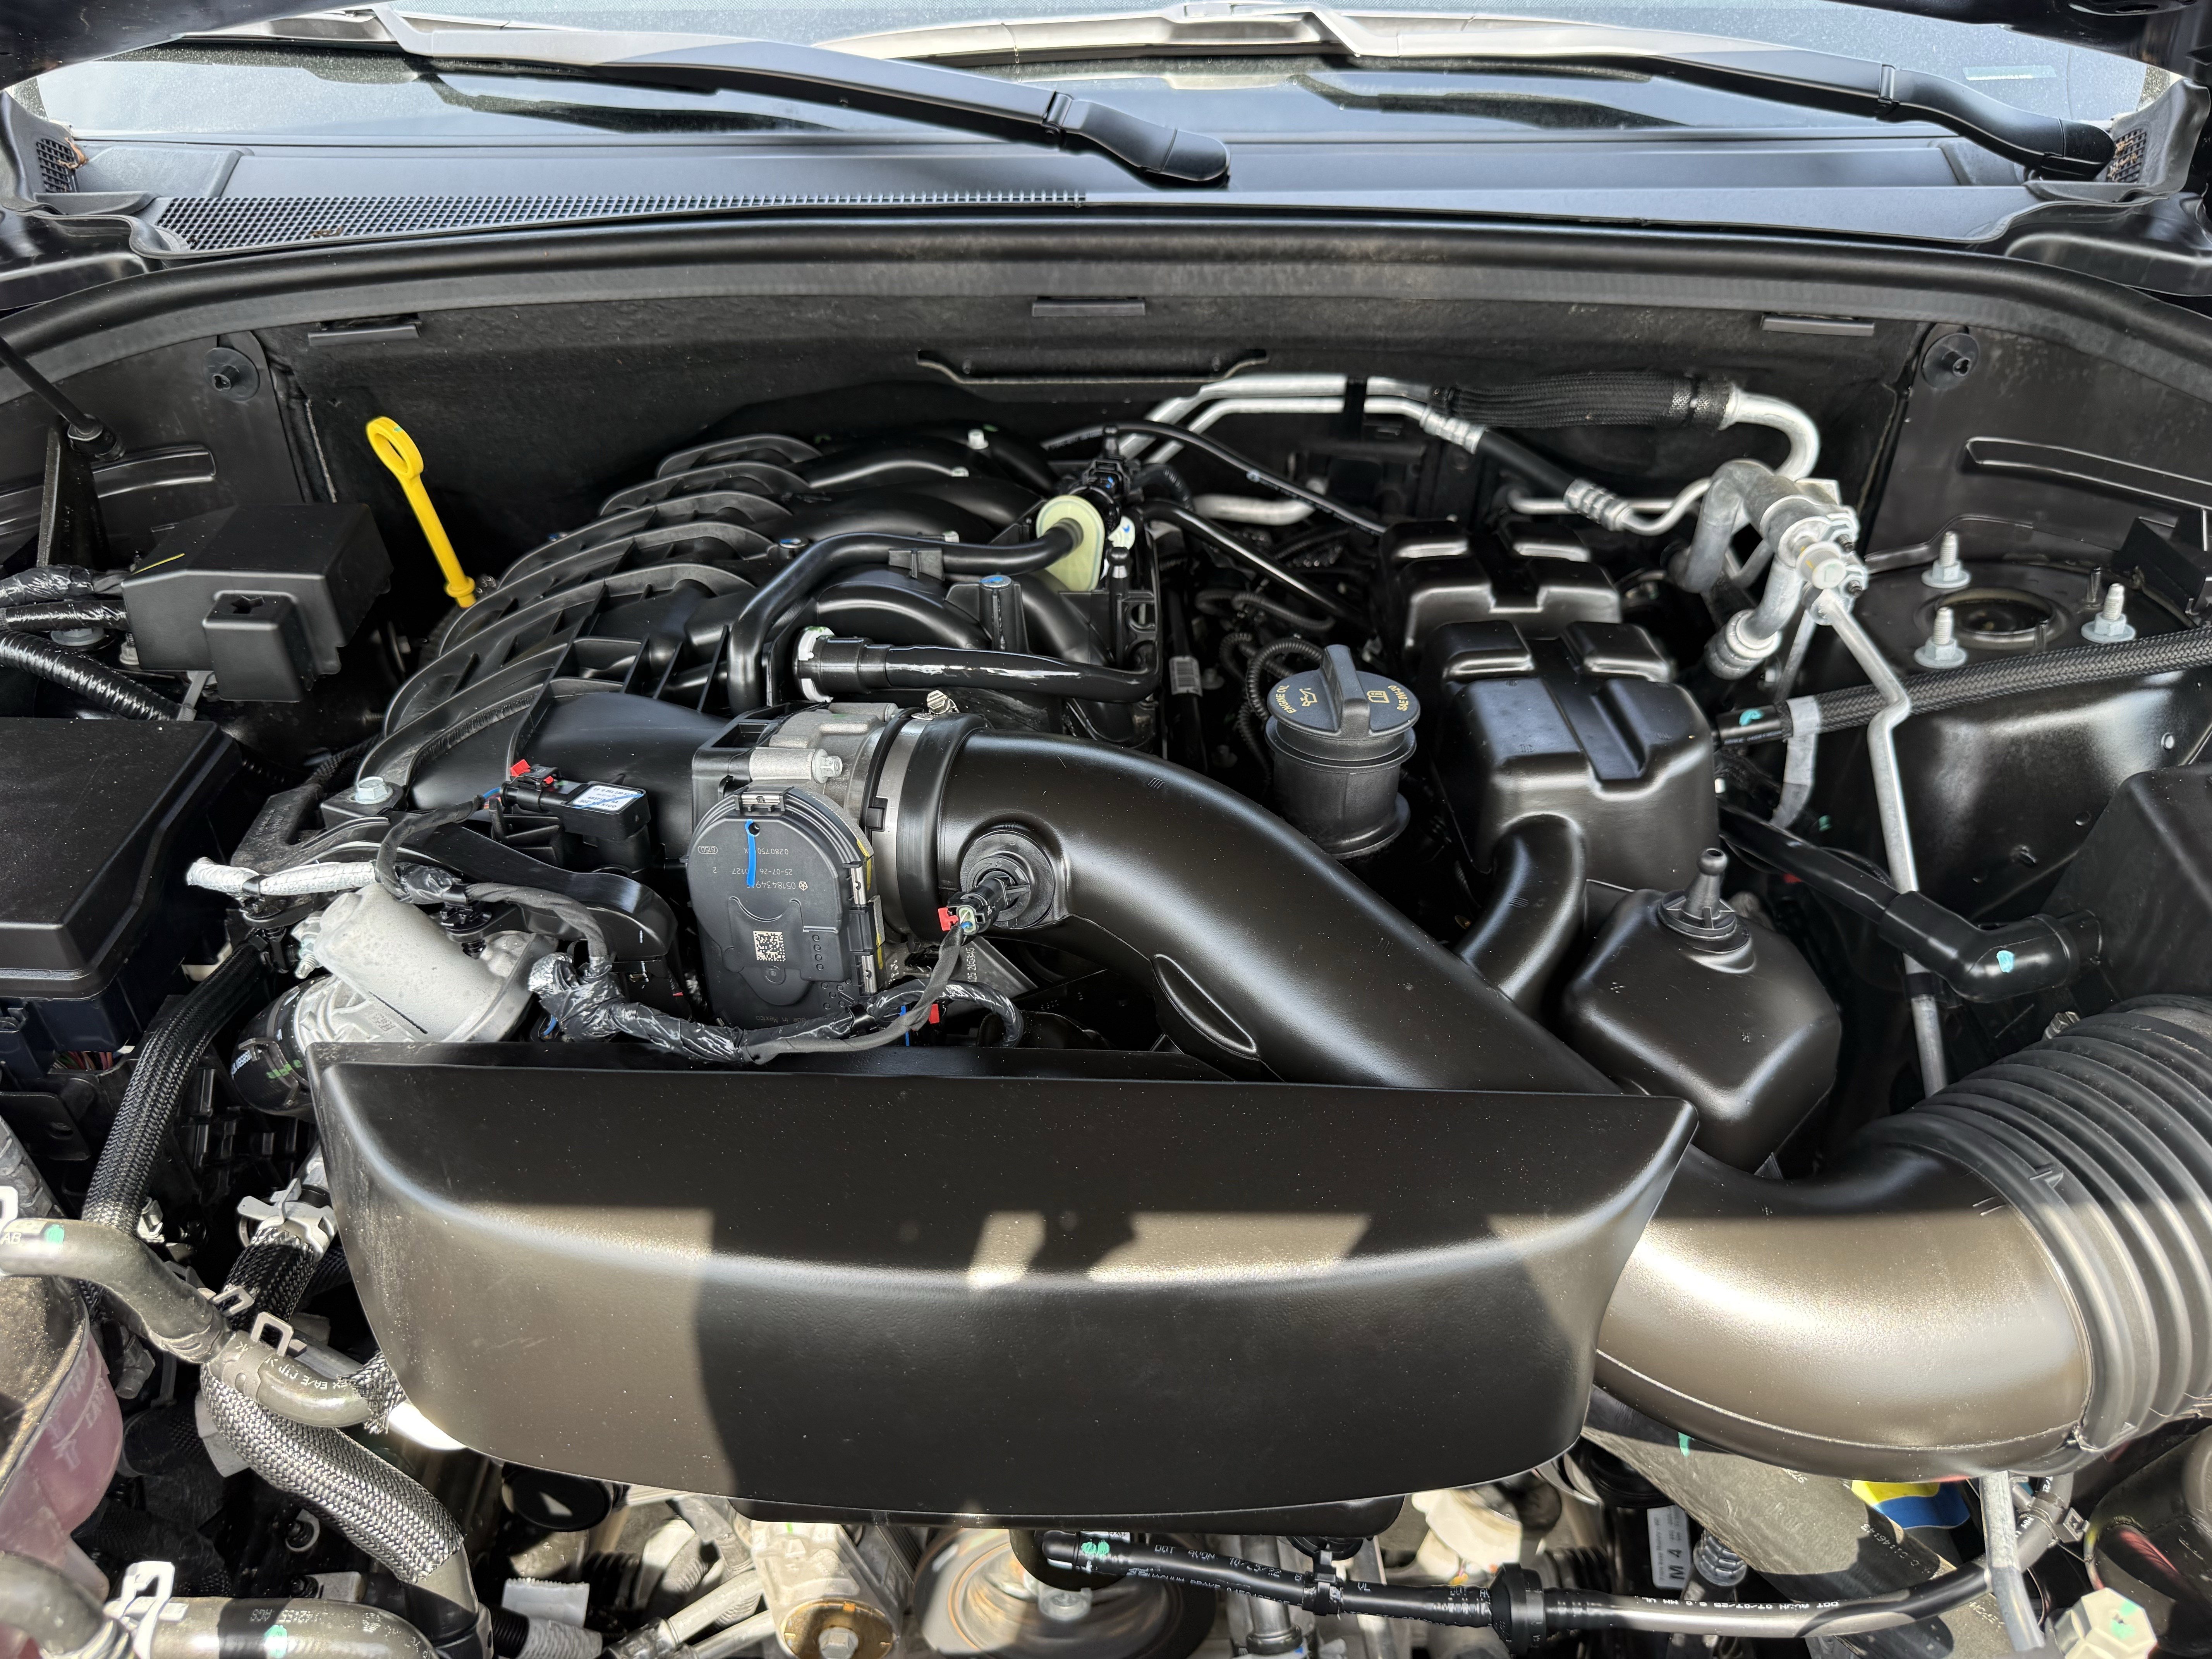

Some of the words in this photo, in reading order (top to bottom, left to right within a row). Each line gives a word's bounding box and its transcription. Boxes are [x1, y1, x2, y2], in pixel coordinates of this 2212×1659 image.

[1276, 685, 1290, 693] OIL
[1275, 694, 1297, 714] ENGINE
[1397, 700, 1409, 711] SAE
[746, 881, 796, 889] 05184349
[1154, 1545, 1175, 1554] DOT
[1668, 1548, 1681, 1557] 4
[1669, 1565, 1685, 1580] M
